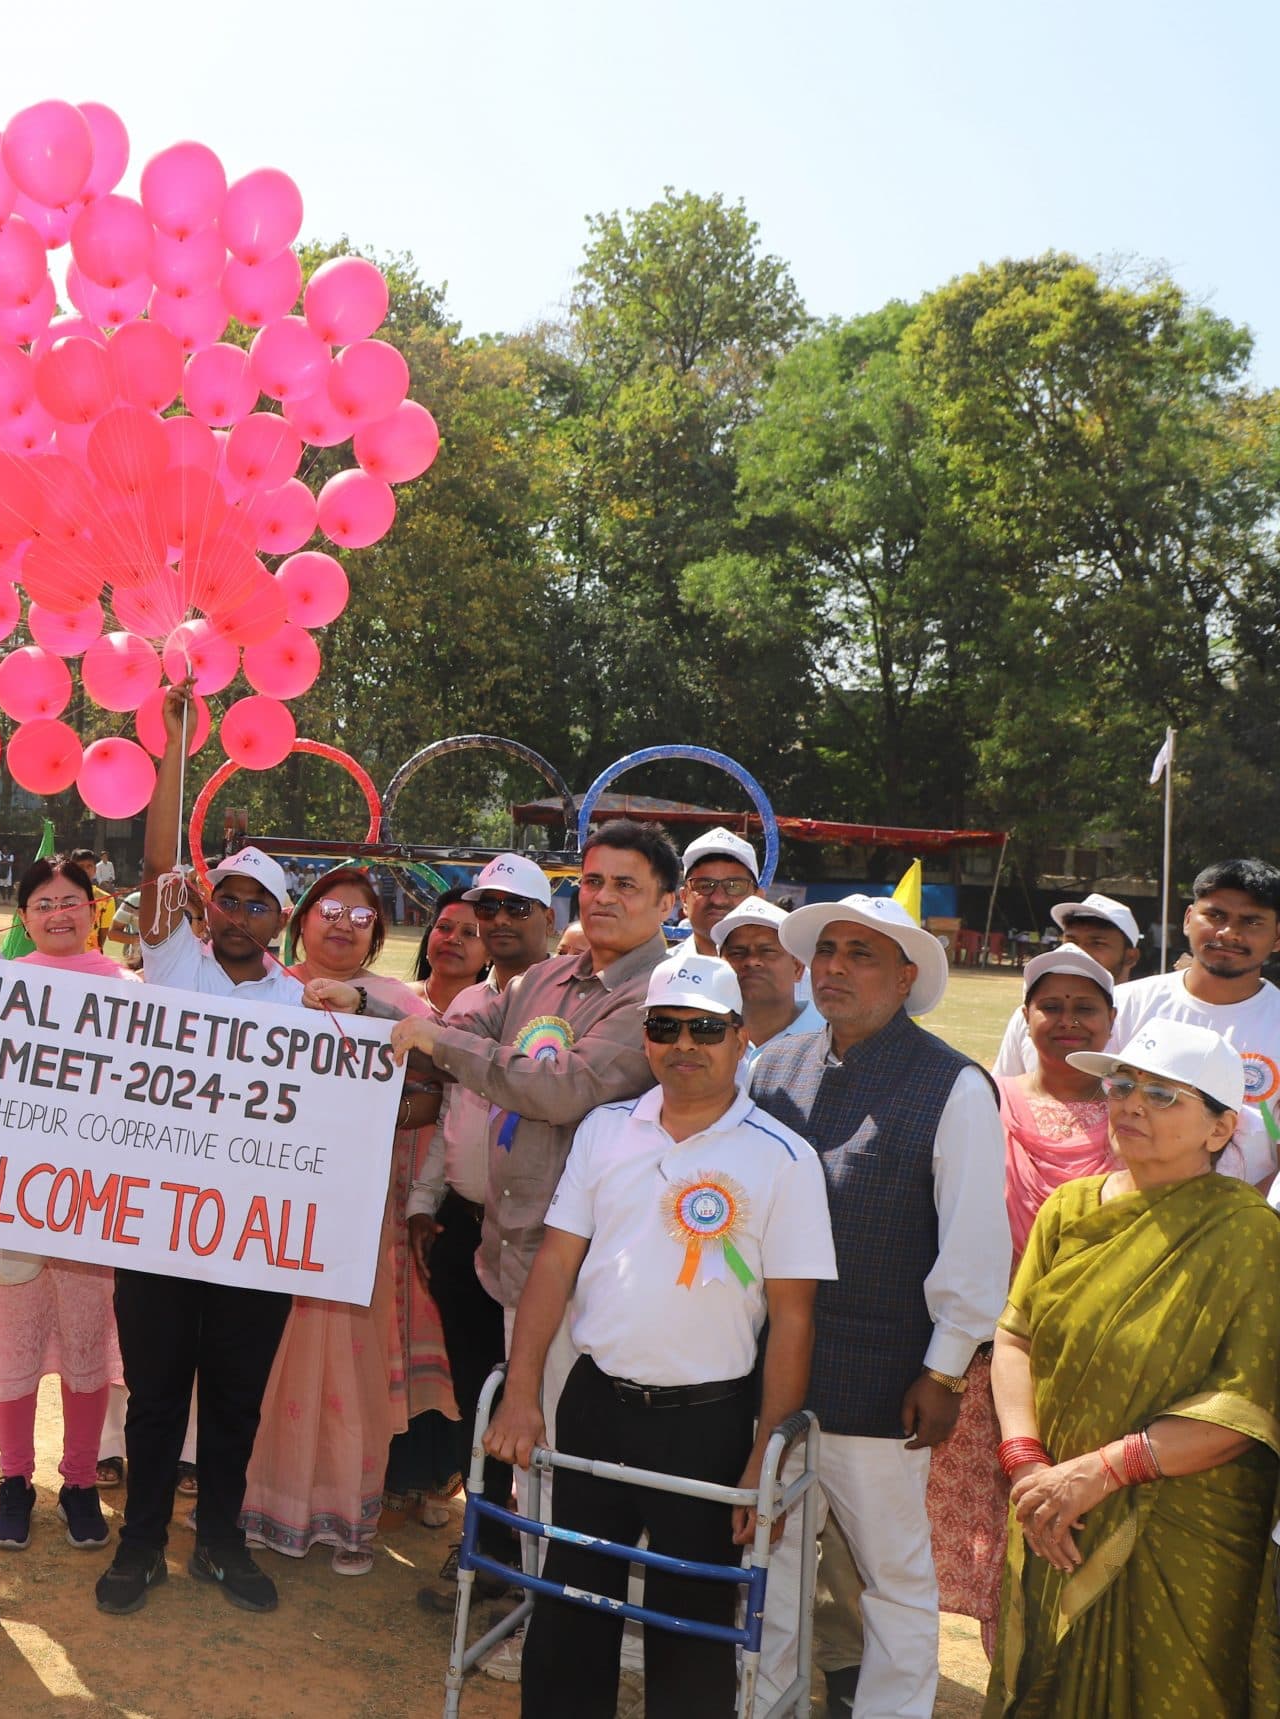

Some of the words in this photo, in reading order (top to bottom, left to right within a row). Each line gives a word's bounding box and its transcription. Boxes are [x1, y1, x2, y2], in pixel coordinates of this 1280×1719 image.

[667, 968, 703, 985] J.C.C
[74, 992, 258, 1063] ATHLETIC
[261, 1026, 395, 1082] SPORTS
[77, 1113, 219, 1160] CO-OPERATIVE
[228, 1137, 327, 1174] COLLEGE
[160, 1181, 225, 1256] TO
[233, 1195, 324, 1272] ALL
